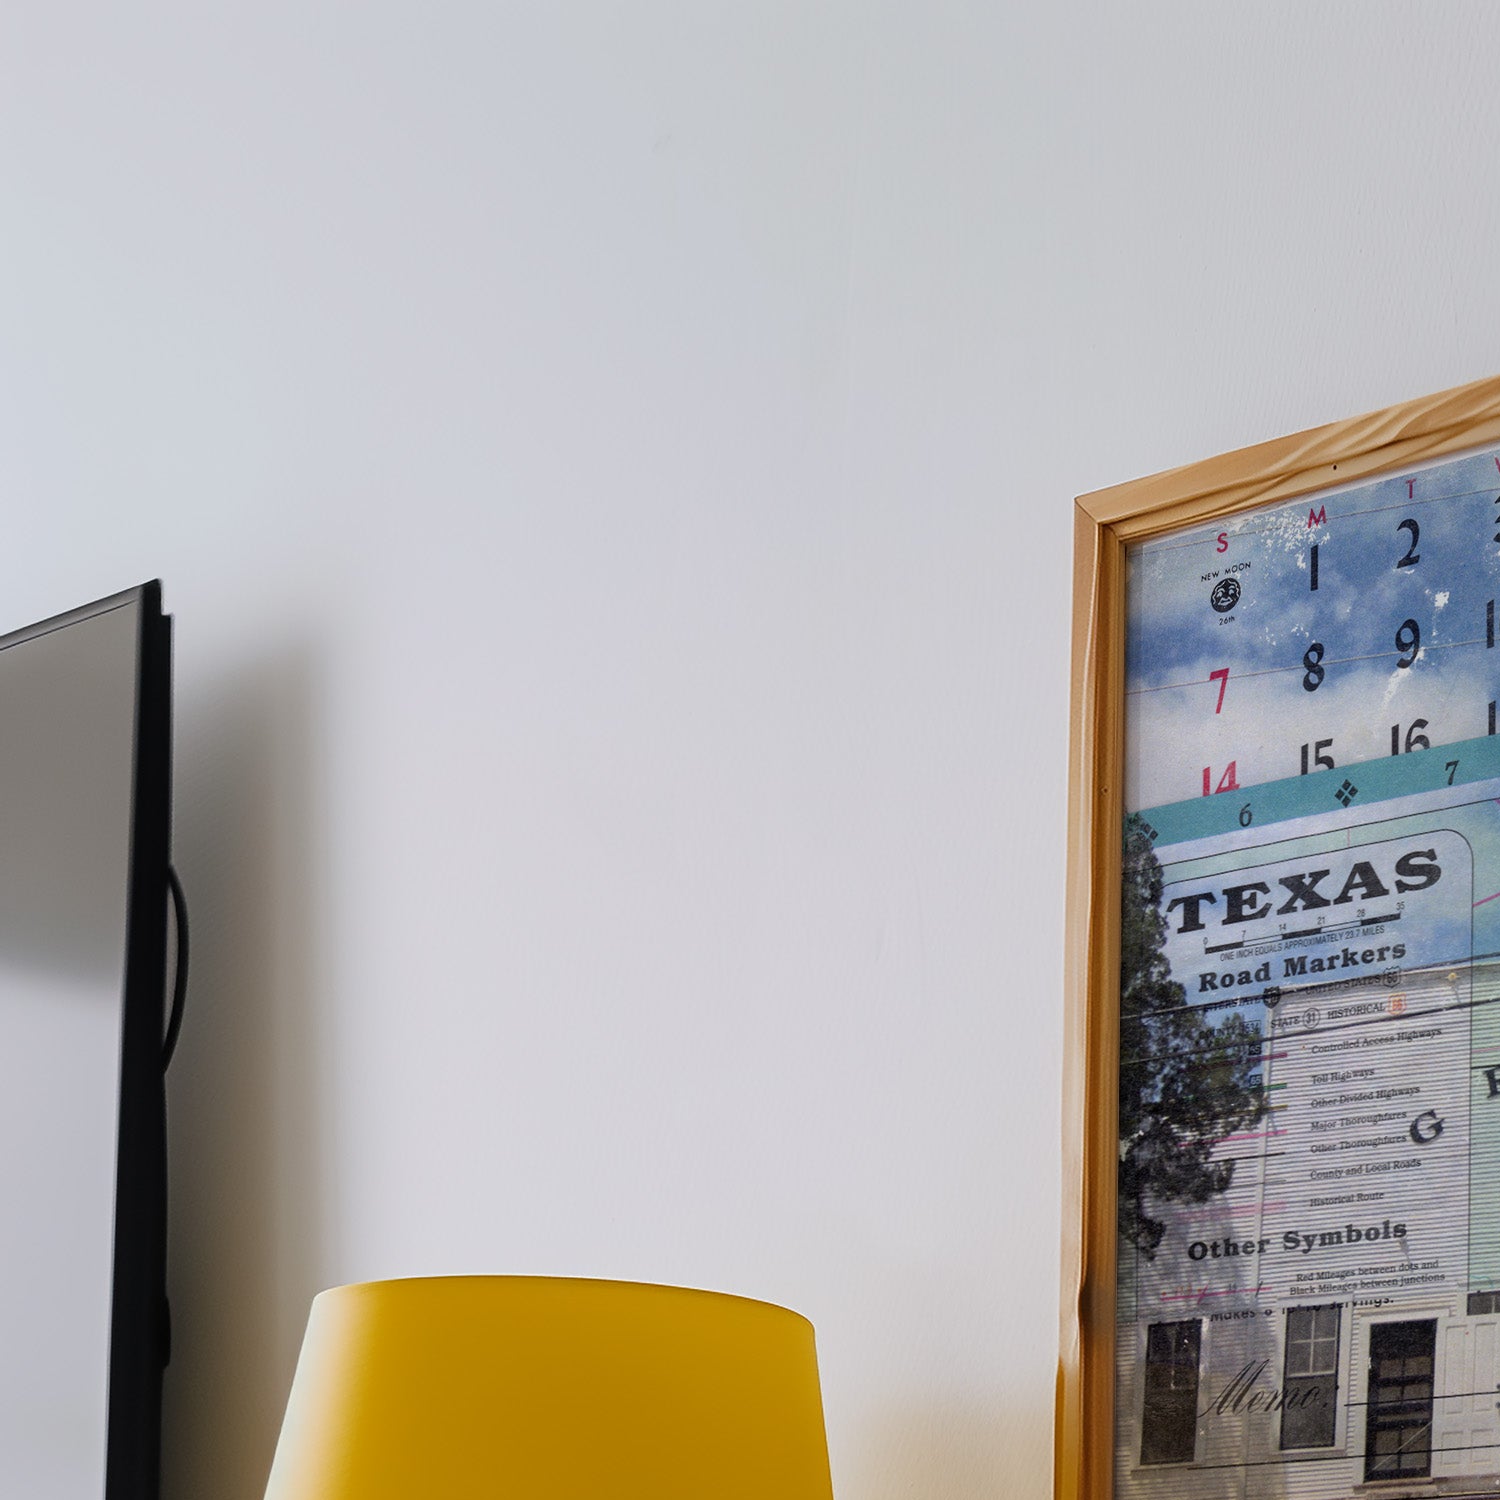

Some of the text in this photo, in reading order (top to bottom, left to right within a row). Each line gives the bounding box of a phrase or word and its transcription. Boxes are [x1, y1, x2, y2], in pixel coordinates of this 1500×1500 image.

[1216, 532, 1229, 553] S
[1307, 505, 1327, 528] M
[1406, 479, 1418, 499] T
[1310, 545, 1319, 591] 1
[1397, 519, 1420, 569] 2
[1201, 561, 1252, 583] NEW MOON
[1209, 668, 1230, 715] 7
[1302, 643, 1326, 692] 8
[1395, 619, 1421, 669] 9
[1202, 761, 1240, 797] 14
[1300, 738, 1334, 776] 15
[1391, 719, 1431, 757] 16
[1239, 760, 1460, 827] 6 7
[1166, 849, 1442, 934] TEXAS
[1284, 926, 1385, 950] APPROXIMATELY MILES
[1198, 943, 1407, 992] Road Markers
[1327, 1002, 1386, 1020] HISTORICAL
[1311, 1028, 1443, 1055] Controlled Access Highways
[1330, 1068, 1376, 1085] Highways
[1339, 1086, 1421, 1105] Divided Highways
[1311, 1110, 1407, 1133] Major Thoroughfares
[1311, 1134, 1407, 1154] Other Thoroughfares
[1310, 1158, 1422, 1181] County and Local Roads
[1310, 1191, 1385, 1207] Historical Route
[1187, 1219, 1407, 1262] Other Symbols
[1316, 1260, 1440, 1282] Mileages between and
[1318, 1282, 1358, 1296] Mileages
[1360, 1278, 1398, 1289] between
[1400, 1271, 1446, 1287] junctions
